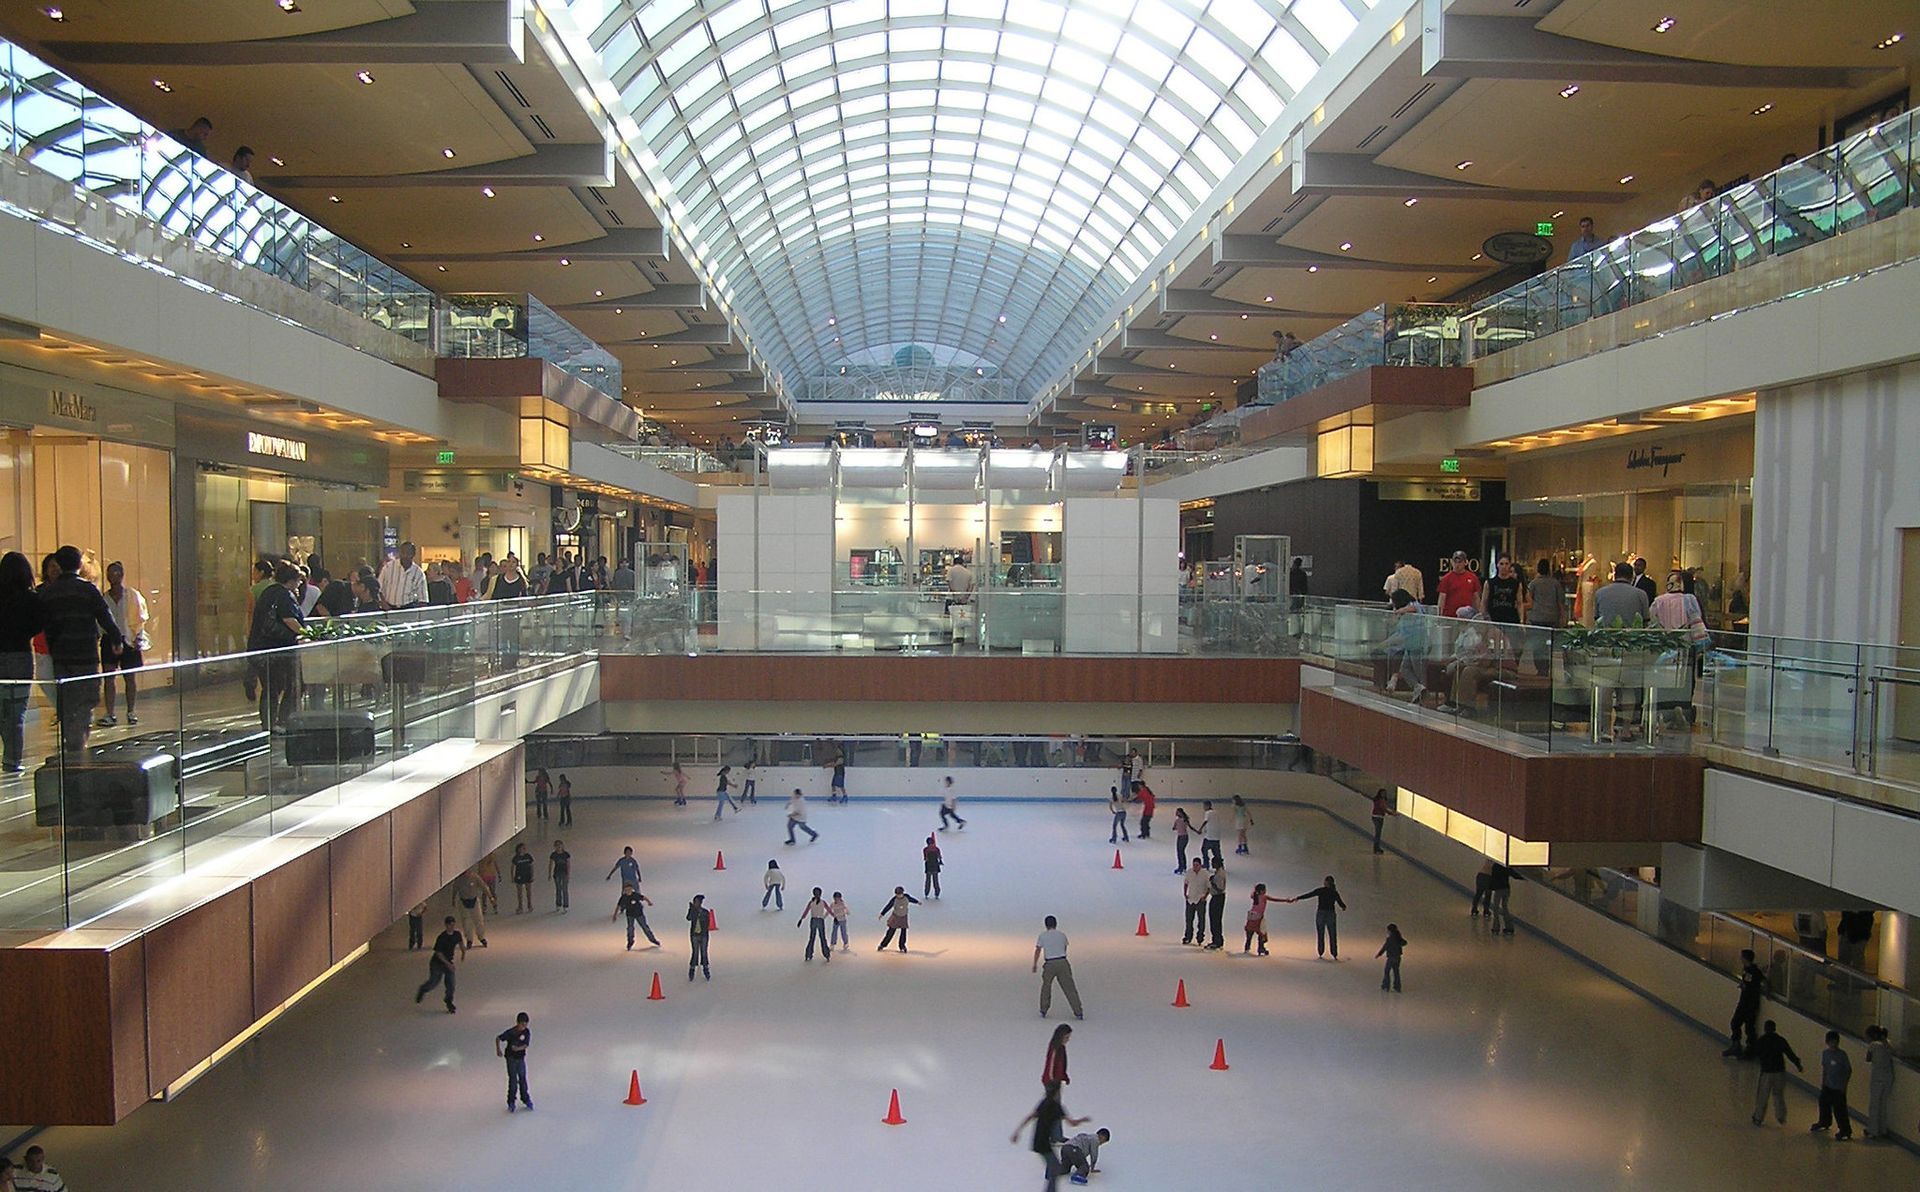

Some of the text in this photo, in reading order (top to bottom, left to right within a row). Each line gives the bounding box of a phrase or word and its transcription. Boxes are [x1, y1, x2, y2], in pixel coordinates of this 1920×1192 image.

[1537, 223, 1553, 236] EXIT
[51, 390, 97, 422] MaxMara
[439, 452, 454, 464] EXIT
[1443, 459, 1459, 472] EXIT
